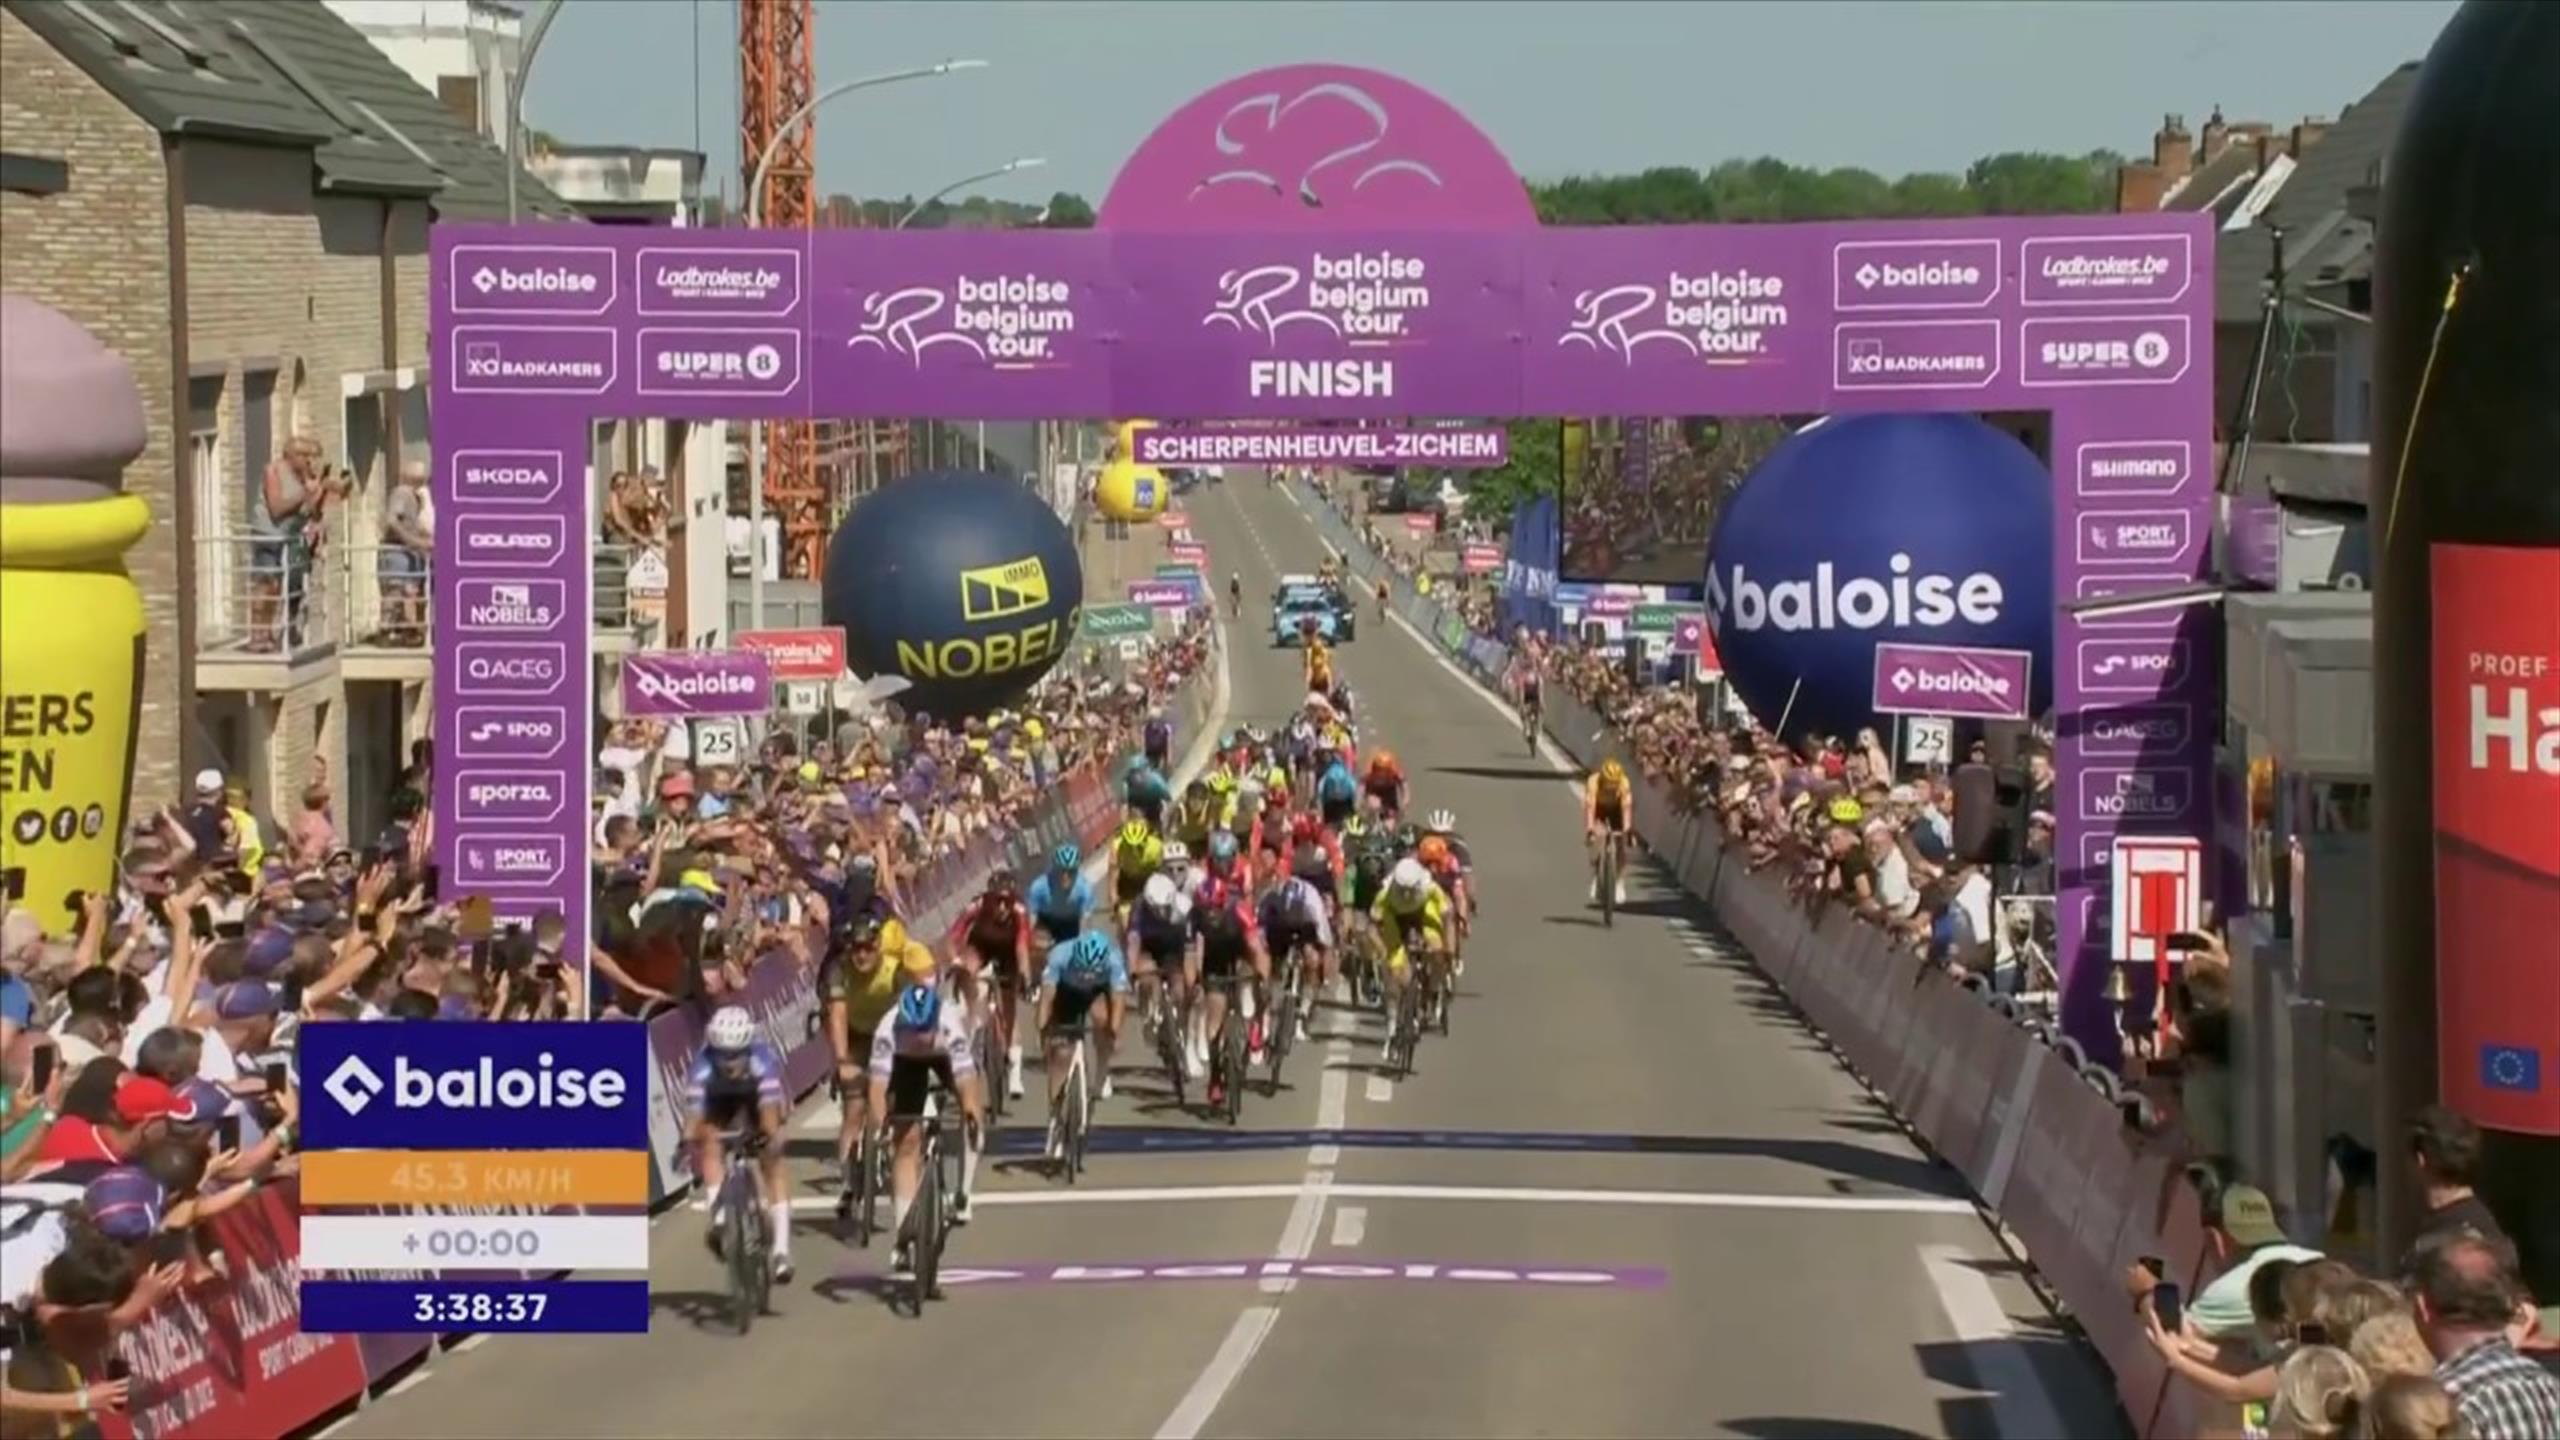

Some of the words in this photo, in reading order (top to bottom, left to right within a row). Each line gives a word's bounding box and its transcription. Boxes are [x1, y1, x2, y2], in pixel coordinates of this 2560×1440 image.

[656, 266, 781, 289] Ladbrokes.be
[1314, 251, 1426, 280] baloise
[1883, 260, 1980, 287] baloise
[2042, 254, 2170, 278] Ladbrokes.be
[500, 267, 597, 291] baloise
[958, 274, 1069, 302] baloise
[1669, 271, 1783, 299] baloise
[1309, 281, 1429, 312] belgium
[954, 305, 1074, 336] belgium
[1342, 307, 1409, 336] tour.
[1665, 300, 1788, 332] belgium
[986, 330, 1054, 358] tour.
[1699, 324, 1767, 353] tour.
[657, 351, 743, 372] SUPER
[1884, 354, 1985, 371] BADKAMERS
[2042, 341, 2131, 364] SUPER
[502, 361, 602, 377] BADKAMERS
[1250, 360, 1394, 397] FINISH
[1143, 433, 1498, 460] SCHERPENHEUVEL-ZICHEM
[2091, 459, 2177, 478] SHIMANO
[1004, 561, 1040, 585] IMMO
[1732, 552, 2004, 632] baloise
[470, 606, 550, 624] NOBELS
[2469, 652, 2549, 678] PROEF
[665, 669, 756, 695] baloise
[1917, 670, 2011, 696] baloise
[4, 691, 95, 736] ERS
[702, 732, 734, 754] 25
[1913, 729, 1946, 751] 25
[2095, 795, 2177, 813] NOBELS
